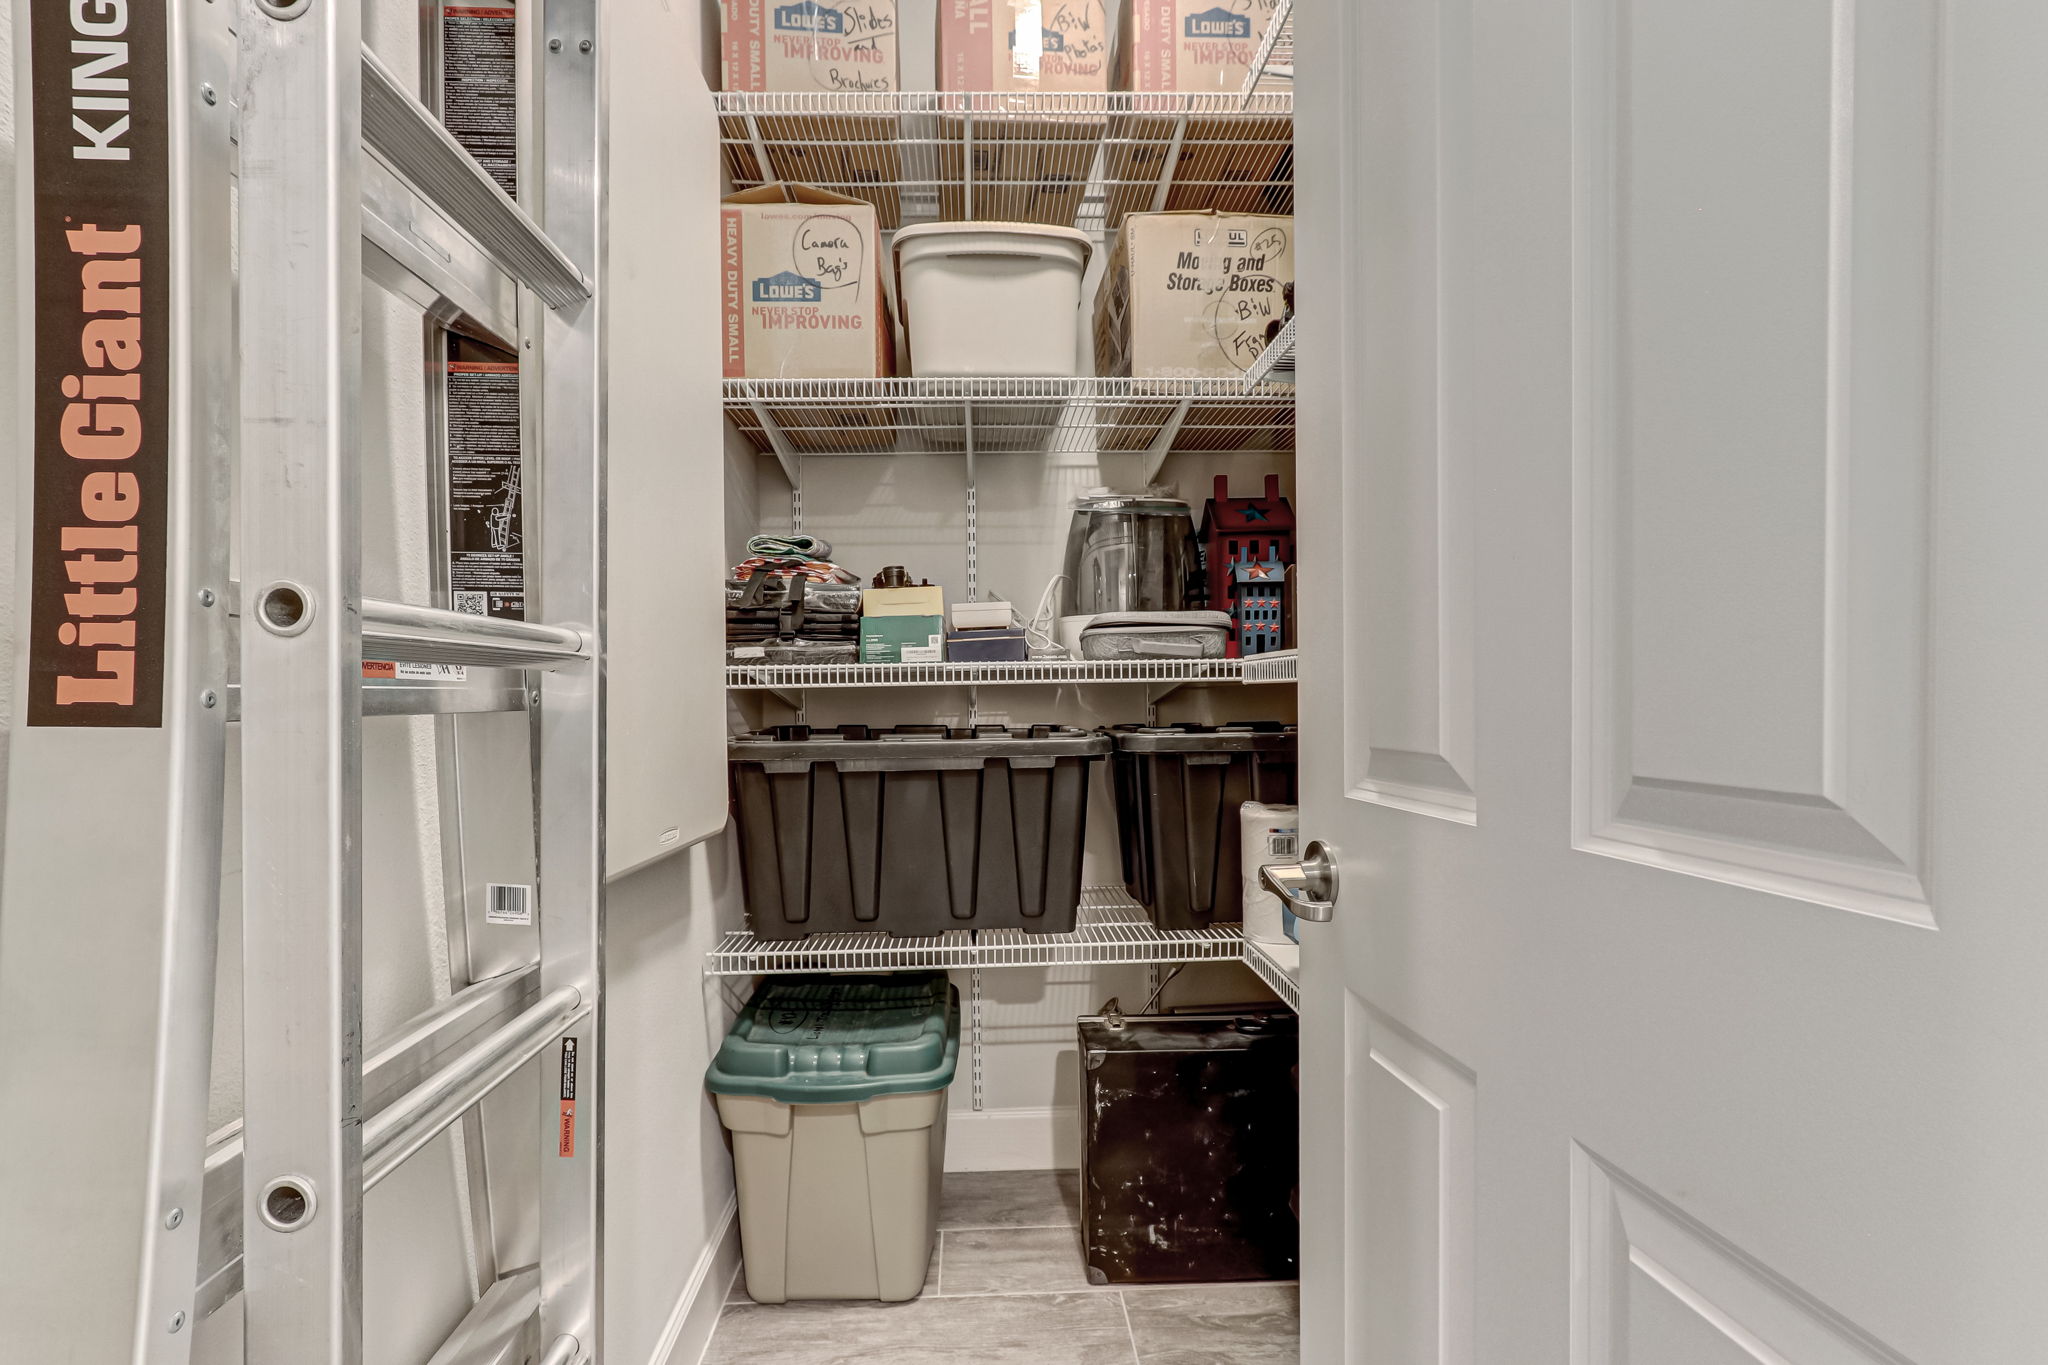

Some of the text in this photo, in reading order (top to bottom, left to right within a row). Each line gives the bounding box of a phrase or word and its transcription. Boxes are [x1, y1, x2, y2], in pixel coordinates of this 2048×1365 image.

[781, 10, 837, 31] LOWE'S
[844, 6, 893, 37] Slides
[1191, 19, 1244, 35] LOWE'S
[773, 34, 841, 47] NEVER STOP
[853, 37, 879, 52] and
[1160, 6, 1172, 91] DUTY SMAL
[1184, 42, 1249, 51] NEVER STOP
[783, 42, 884, 64] IMPROVING
[750, 39, 761, 91] SMALL
[1253, 234, 1282, 252] #25
[1236, 253, 1266, 272] and
[726, 217, 740, 364] HEAVY DUTY SMALL
[759, 282, 815, 299] LOWE'S
[1228, 274, 1275, 293] Boxes
[751, 306, 819, 316] NEVER STOP
[762, 315, 863, 330] IMPROVING
[56, 0, 143, 706] Little Giant KING
[563, 1118, 571, 1153] WARNING
